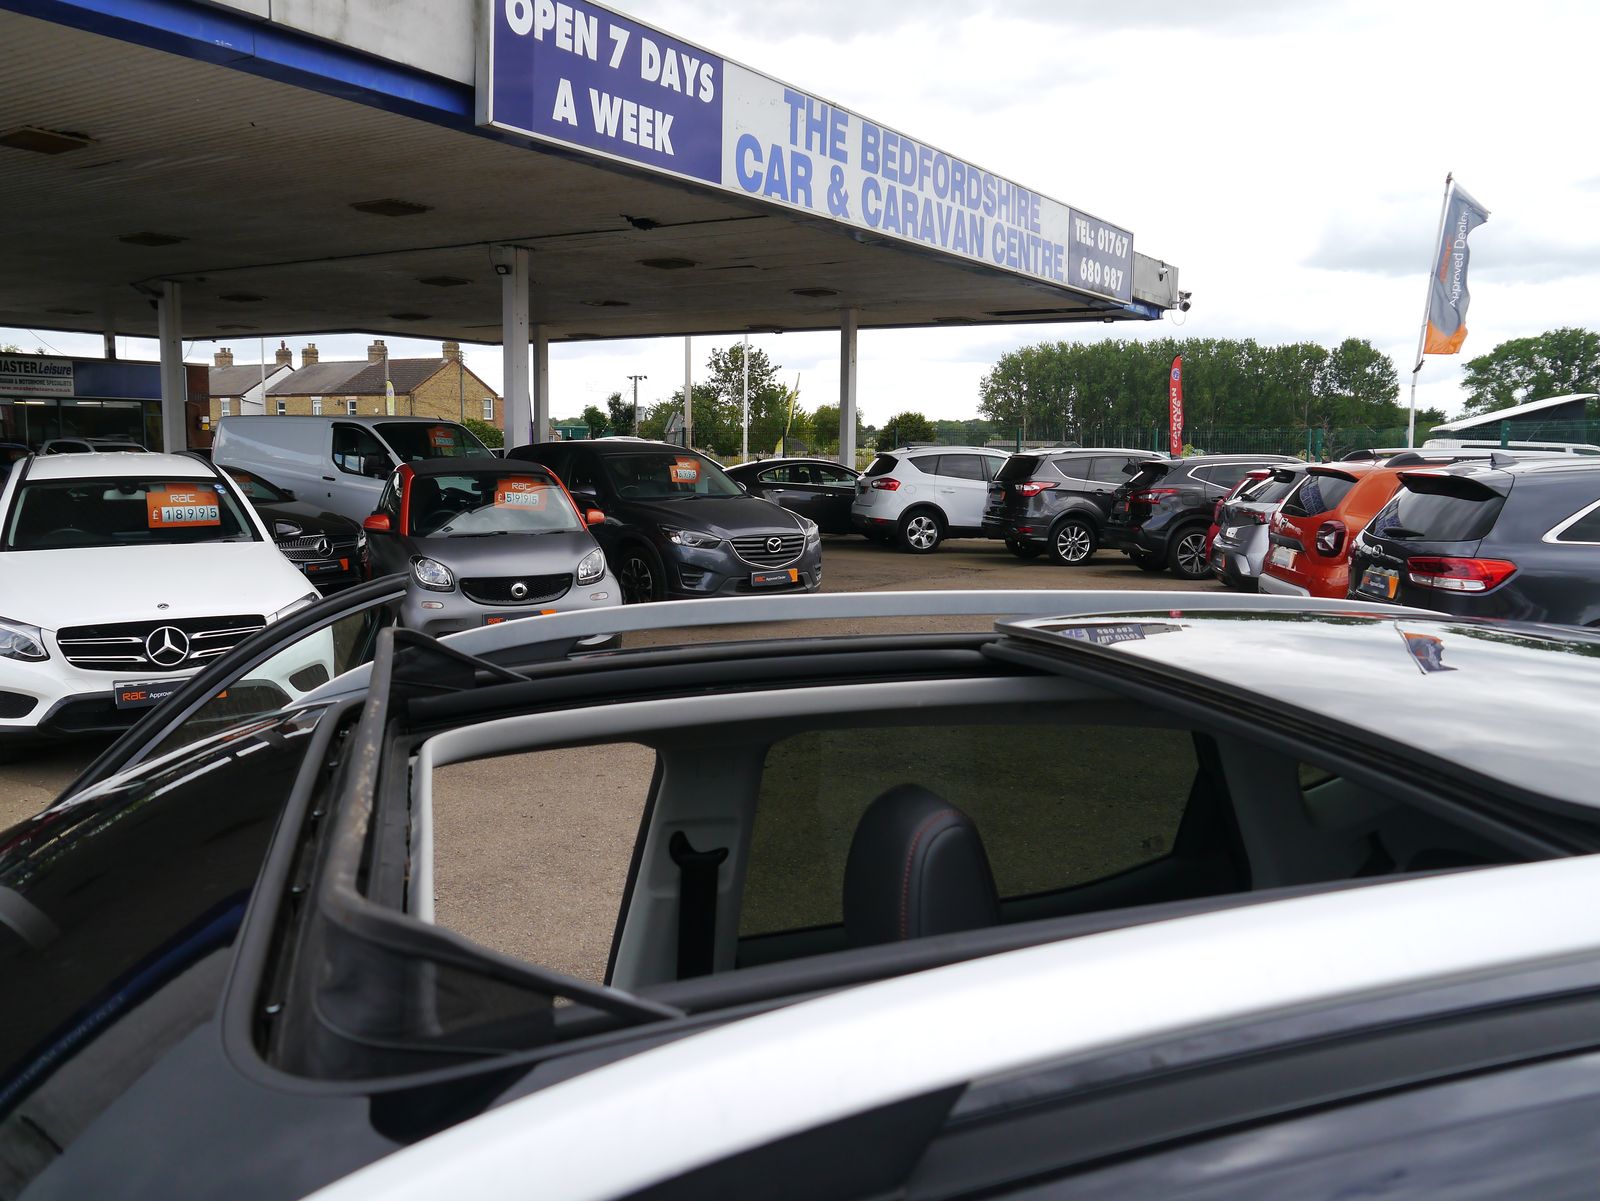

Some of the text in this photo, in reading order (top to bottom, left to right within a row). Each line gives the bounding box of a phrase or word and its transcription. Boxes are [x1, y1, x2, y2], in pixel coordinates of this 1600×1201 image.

[505, 0, 715, 103] OPEN 7 DAYS
[552, 78, 675, 156] A WEEK
[783, 87, 1042, 235] THE BEDFORDSHIRE
[735, 133, 1065, 282] CAR & CARAVAN CENTRE
[1075, 217, 1129, 259] TEL: 01767
[1080, 257, 1124, 291] 680 987
[1449, 210, 1469, 307] Approved Dealer
[38, 362, 72, 375] Leisure
